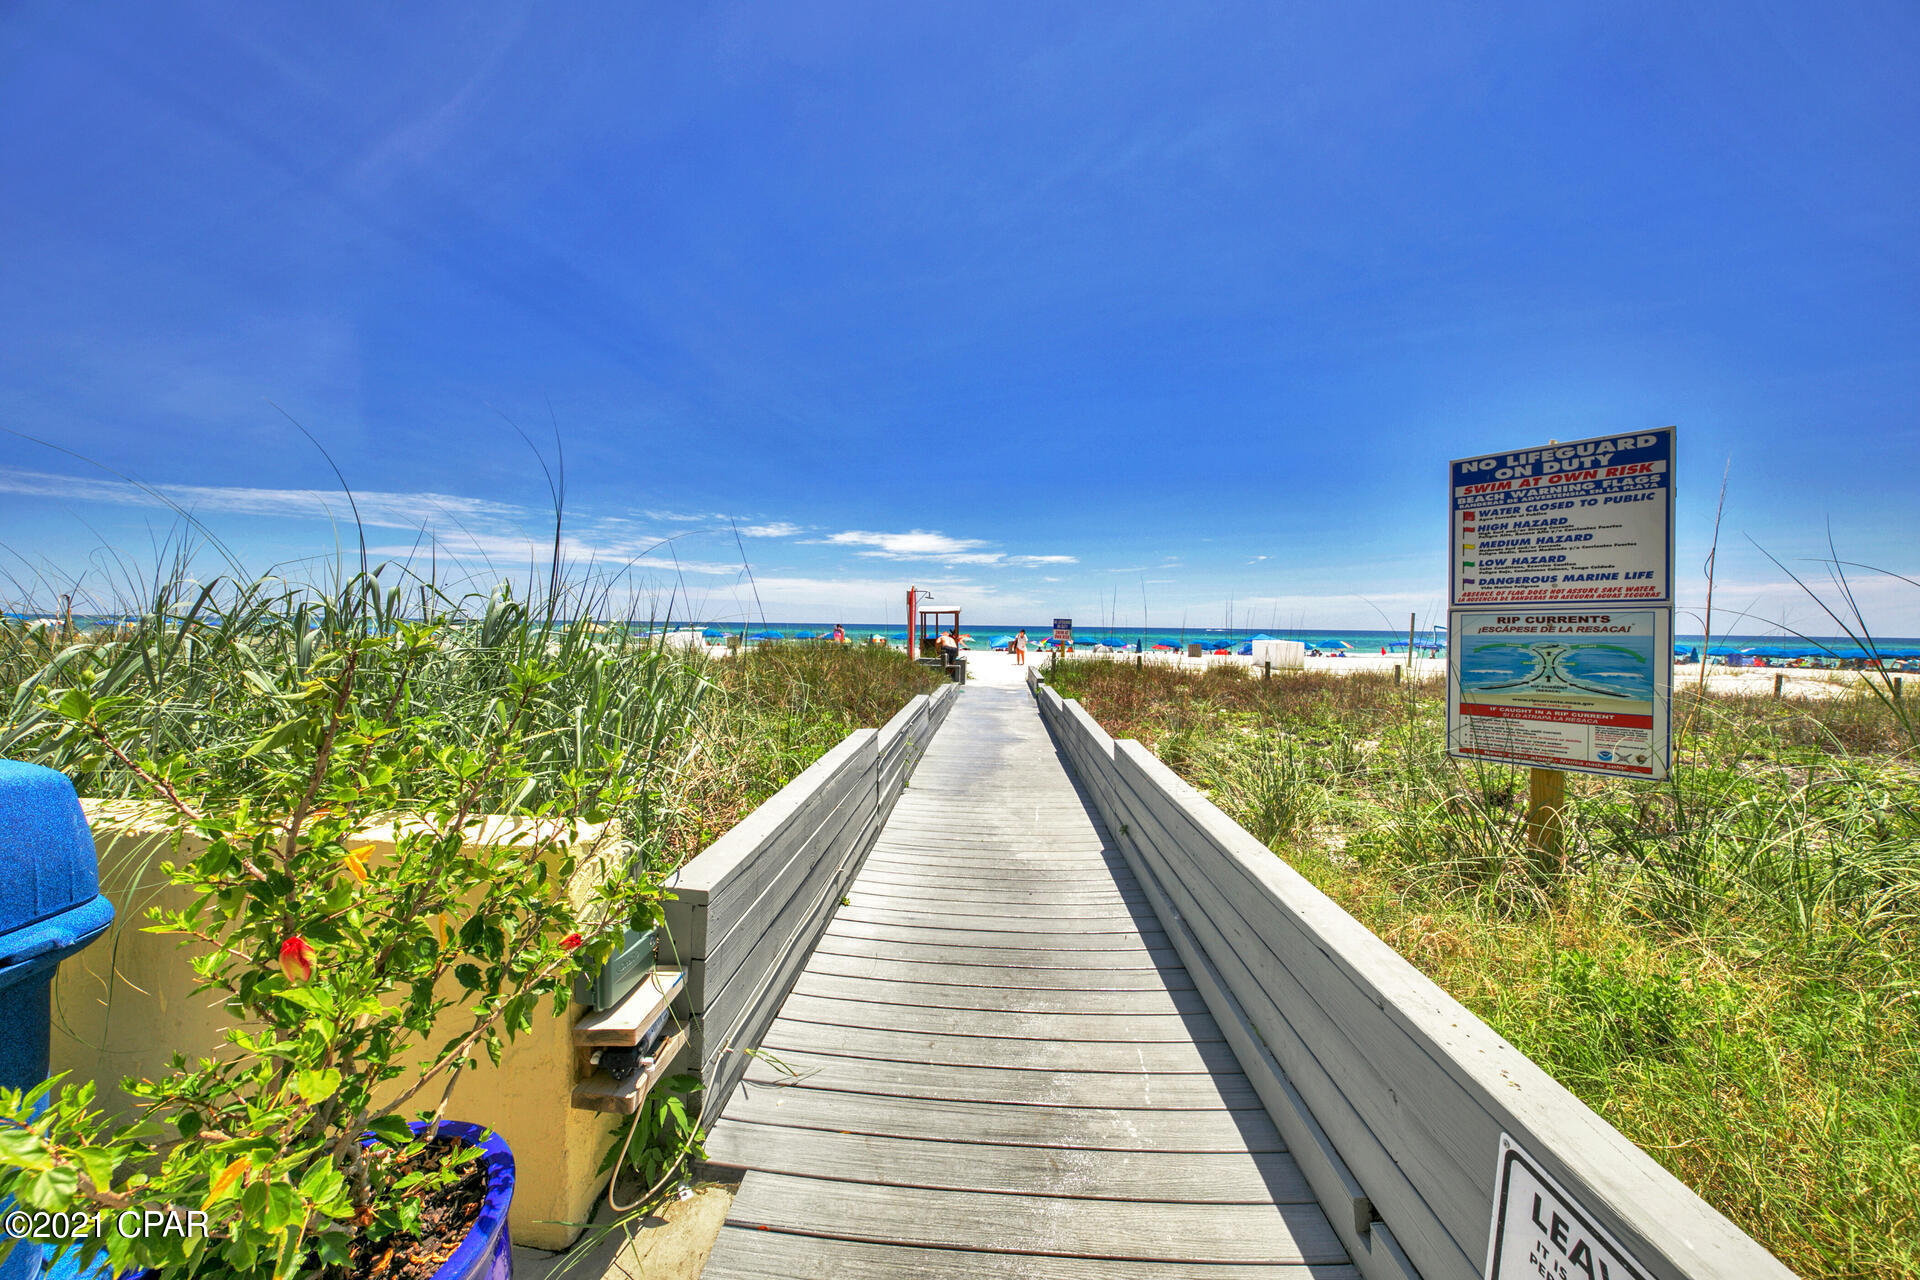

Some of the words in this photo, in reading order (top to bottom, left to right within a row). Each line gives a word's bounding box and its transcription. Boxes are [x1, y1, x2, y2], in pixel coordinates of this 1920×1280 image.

[1462, 459, 1496, 474] NO
[1506, 435, 1656, 466] LIFEGUARD
[1494, 464, 1532, 479] ON
[1543, 453, 1614, 474] DUTY
[1458, 493, 1504, 505] BEACH
[1511, 482, 1596, 498] WARNING
[1602, 474, 1661, 488] FLAGS
[1464, 480, 1512, 495] SWIM
[1518, 477, 1542, 488] AT
[1548, 470, 1598, 484] OWN
[1605, 462, 1654, 477] RISK
[1460, 500, 1504, 508] BANDERAS
[1624, 482, 1659, 490] PLAYA
[1479, 506, 1521, 517] WATER
[1525, 501, 1575, 512] CLOSED
[1580, 498, 1598, 507] TO
[1604, 492, 1656, 504] PUBLIC
[1478, 523, 1508, 532] HIGH
[1513, 518, 1568, 529] HAZARD
[1479, 538, 1531, 548] MEDIUM
[1536, 534, 1593, 544] HAZARD
[1479, 558, 1507, 567] LOW
[1512, 555, 1566, 567] HAZARD
[1478, 576, 1558, 585] DANGEROUS
[1562, 572, 1619, 582] MARINE
[1624, 571, 1654, 580] LIFE
[1525, 616, 1611, 624] CURRENTS
[1536, 1240, 1550, 1260] IT
[1554, 1260, 1568, 1280] IS
